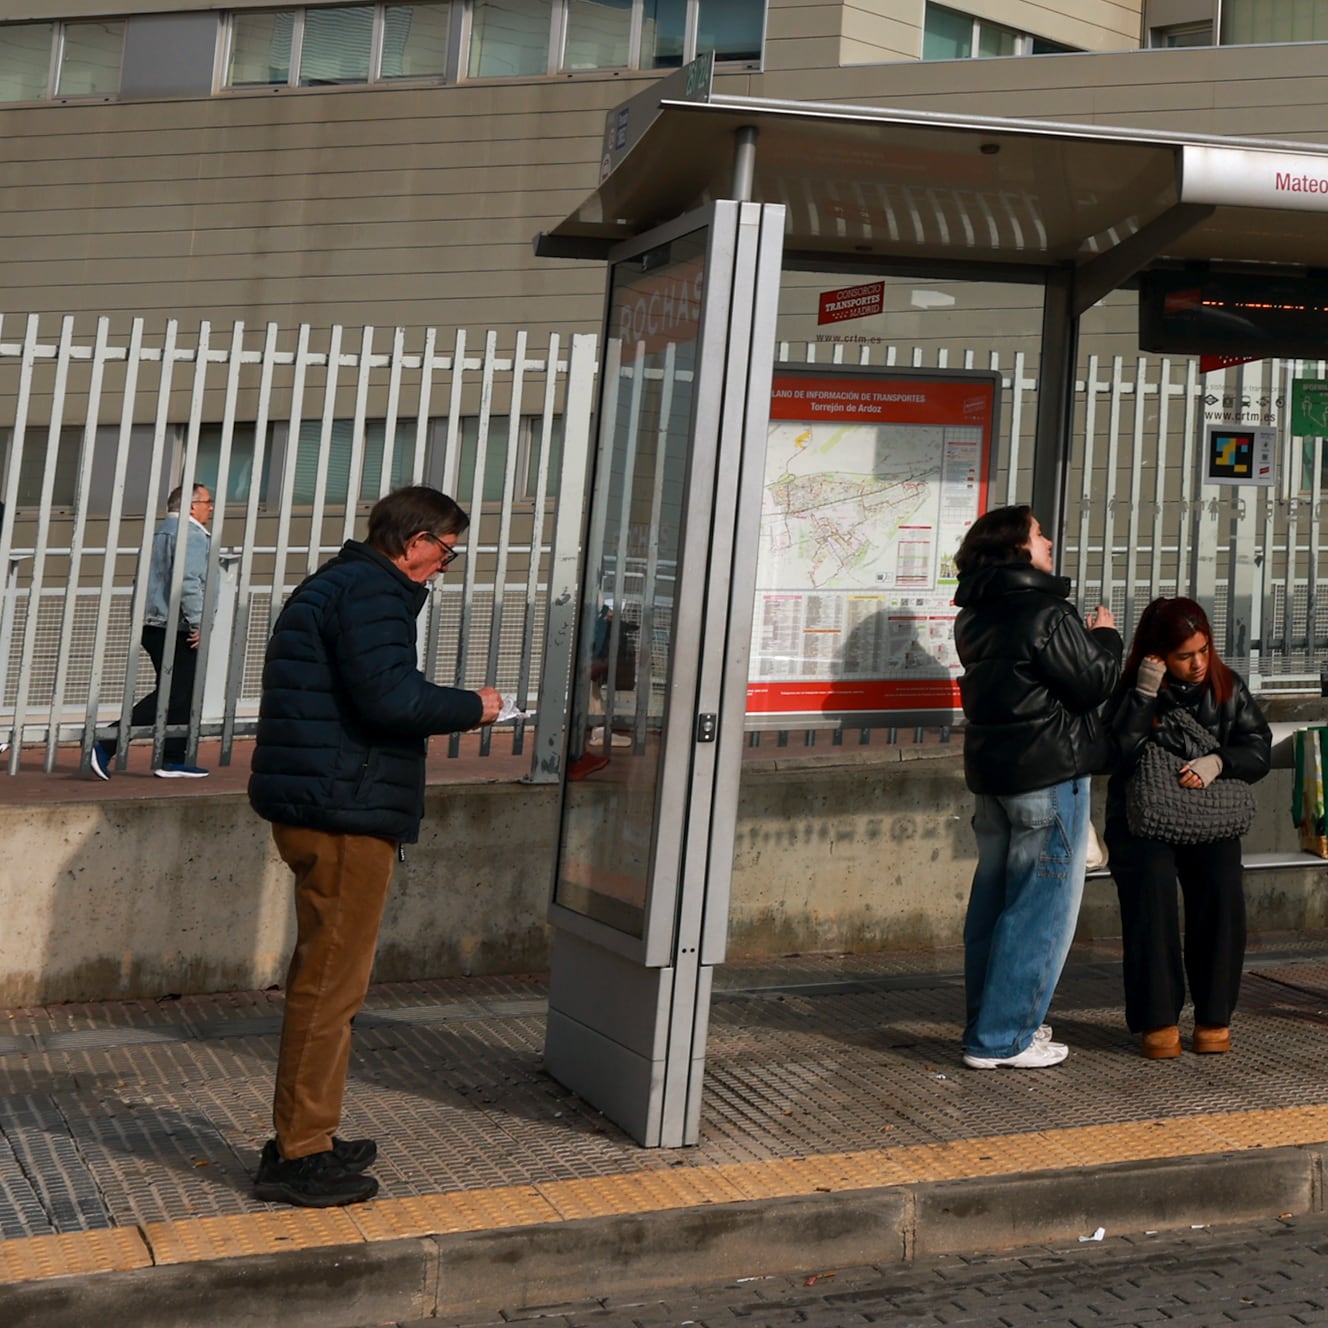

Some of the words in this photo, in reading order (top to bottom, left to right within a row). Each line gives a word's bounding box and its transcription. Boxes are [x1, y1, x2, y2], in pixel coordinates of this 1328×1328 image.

[1275, 172, 1328, 194] Mateo
[836, 284, 881, 300] CONSORCIO
[825, 294, 880, 312] TRANSPORTES
[849, 304, 880, 318] MADRID
[816, 333, 881, 344] www.crtm.es
[771, 389, 792, 399] LANO
[794, 390, 804, 399] DE
[806, 389, 858, 401] INFORMACIÓN
[861, 392, 871, 401] DE
[873, 392, 925, 403] TRANSPORTES
[811, 402, 844, 413] Torrejón
[846, 403, 856, 412] de
[858, 404, 882, 413] Ardoz
[1204, 411, 1276, 422] www.crtm.es
